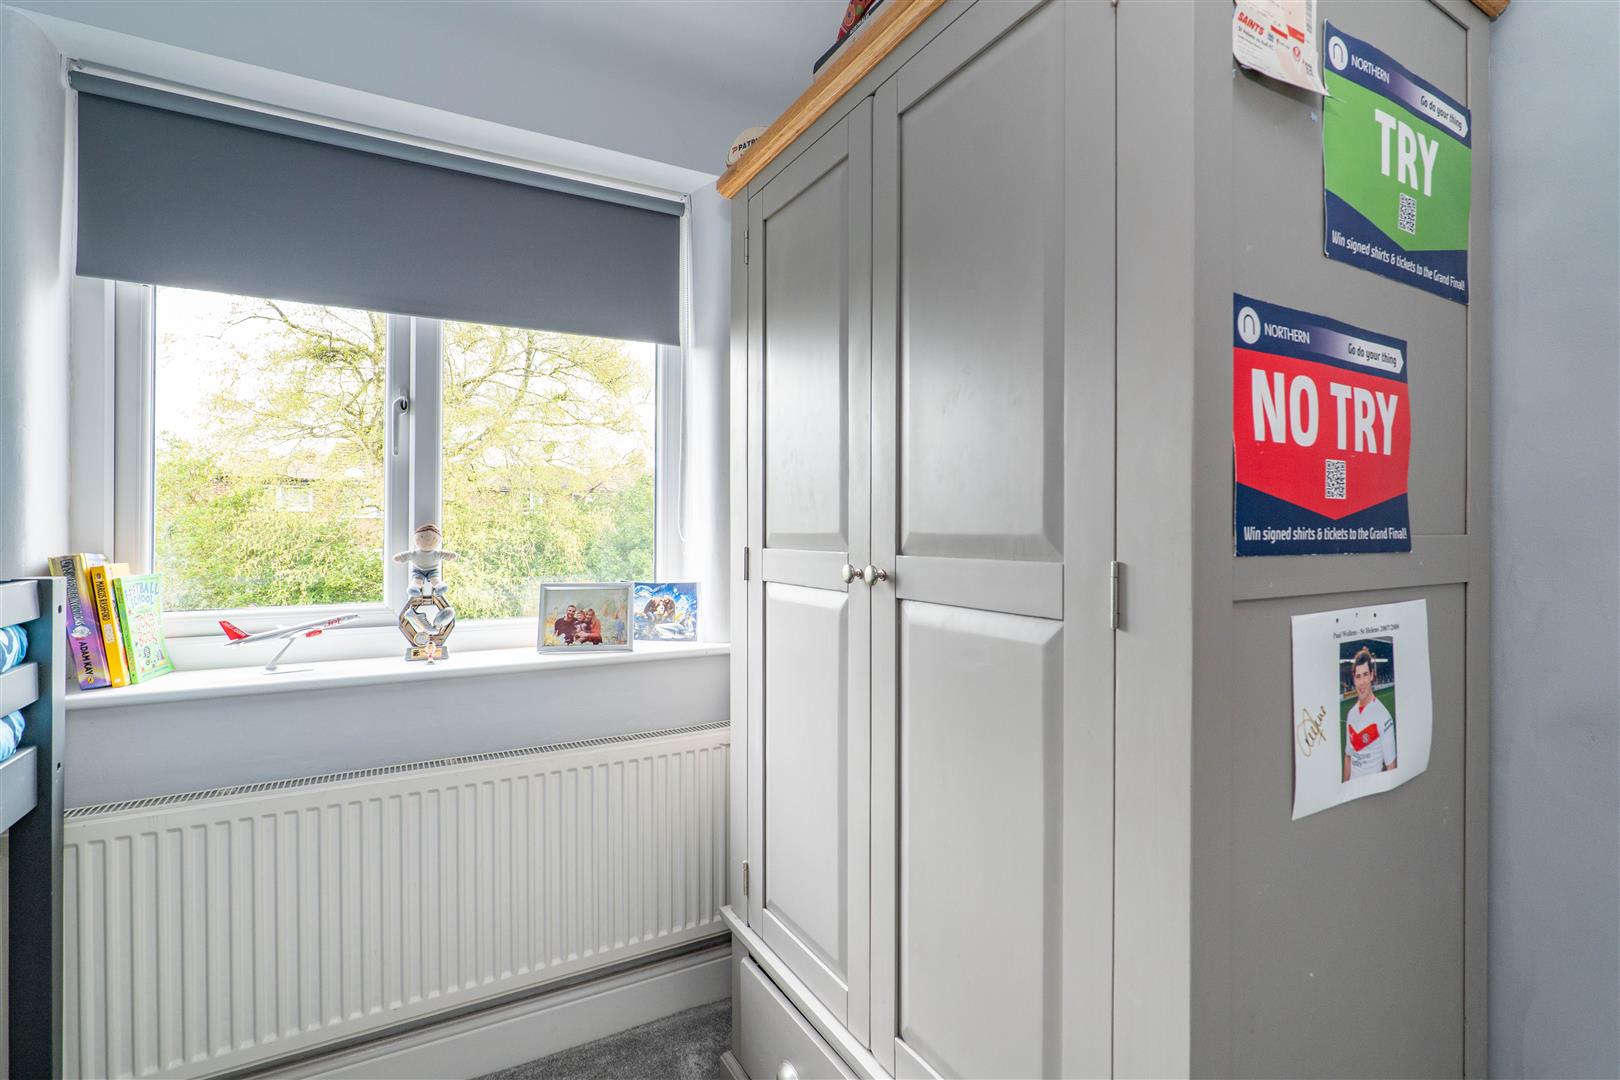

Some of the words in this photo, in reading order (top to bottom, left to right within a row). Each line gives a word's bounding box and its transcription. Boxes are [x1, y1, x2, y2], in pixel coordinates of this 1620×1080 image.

[1238, 12, 1264, 35] SAINTS
[1351, 54, 1390, 84] NORTHERN
[1420, 95, 1429, 108] Go
[1429, 101, 1436, 113] do
[1437, 106, 1449, 118] your
[1450, 114, 1462, 131] thing
[1375, 109, 1439, 197] TRY
[1332, 230, 1345, 247] Win
[1346, 237, 1370, 255] signed
[1371, 246, 1390, 263] shirts
[1390, 253, 1395, 265] &
[1396, 256, 1416, 273] tickets
[1417, 264, 1423, 276] to
[1424, 266, 1433, 279] the
[1433, 270, 1449, 285] Grand
[1450, 275, 1465, 291] Final!
[1264, 322, 1311, 345] NORTHERN
[1348, 343, 1356, 355] Go
[1357, 346, 1364, 358] do
[1366, 350, 1380, 361] your
[1381, 351, 1397, 368] thing
[1252, 368, 1319, 447] NO
[1329, 382, 1398, 456] TRY
[1243, 526, 1261, 541] Win
[1262, 527, 1292, 544] signed
[1293, 527, 1316, 540] shirts
[1317, 528, 1323, 540] &
[1323, 527, 1349, 540] tickets
[1350, 528, 1357, 540] to
[1358, 527, 1369, 540] the
[1370, 527, 1388, 540] Grand
[1389, 527, 1408, 540] Final!
[96, 581, 106, 598] MARCUS
[99, 598, 110, 621] RASHFORD
[78, 642, 91, 661] ADAM
[84, 661, 94, 675] KAY
